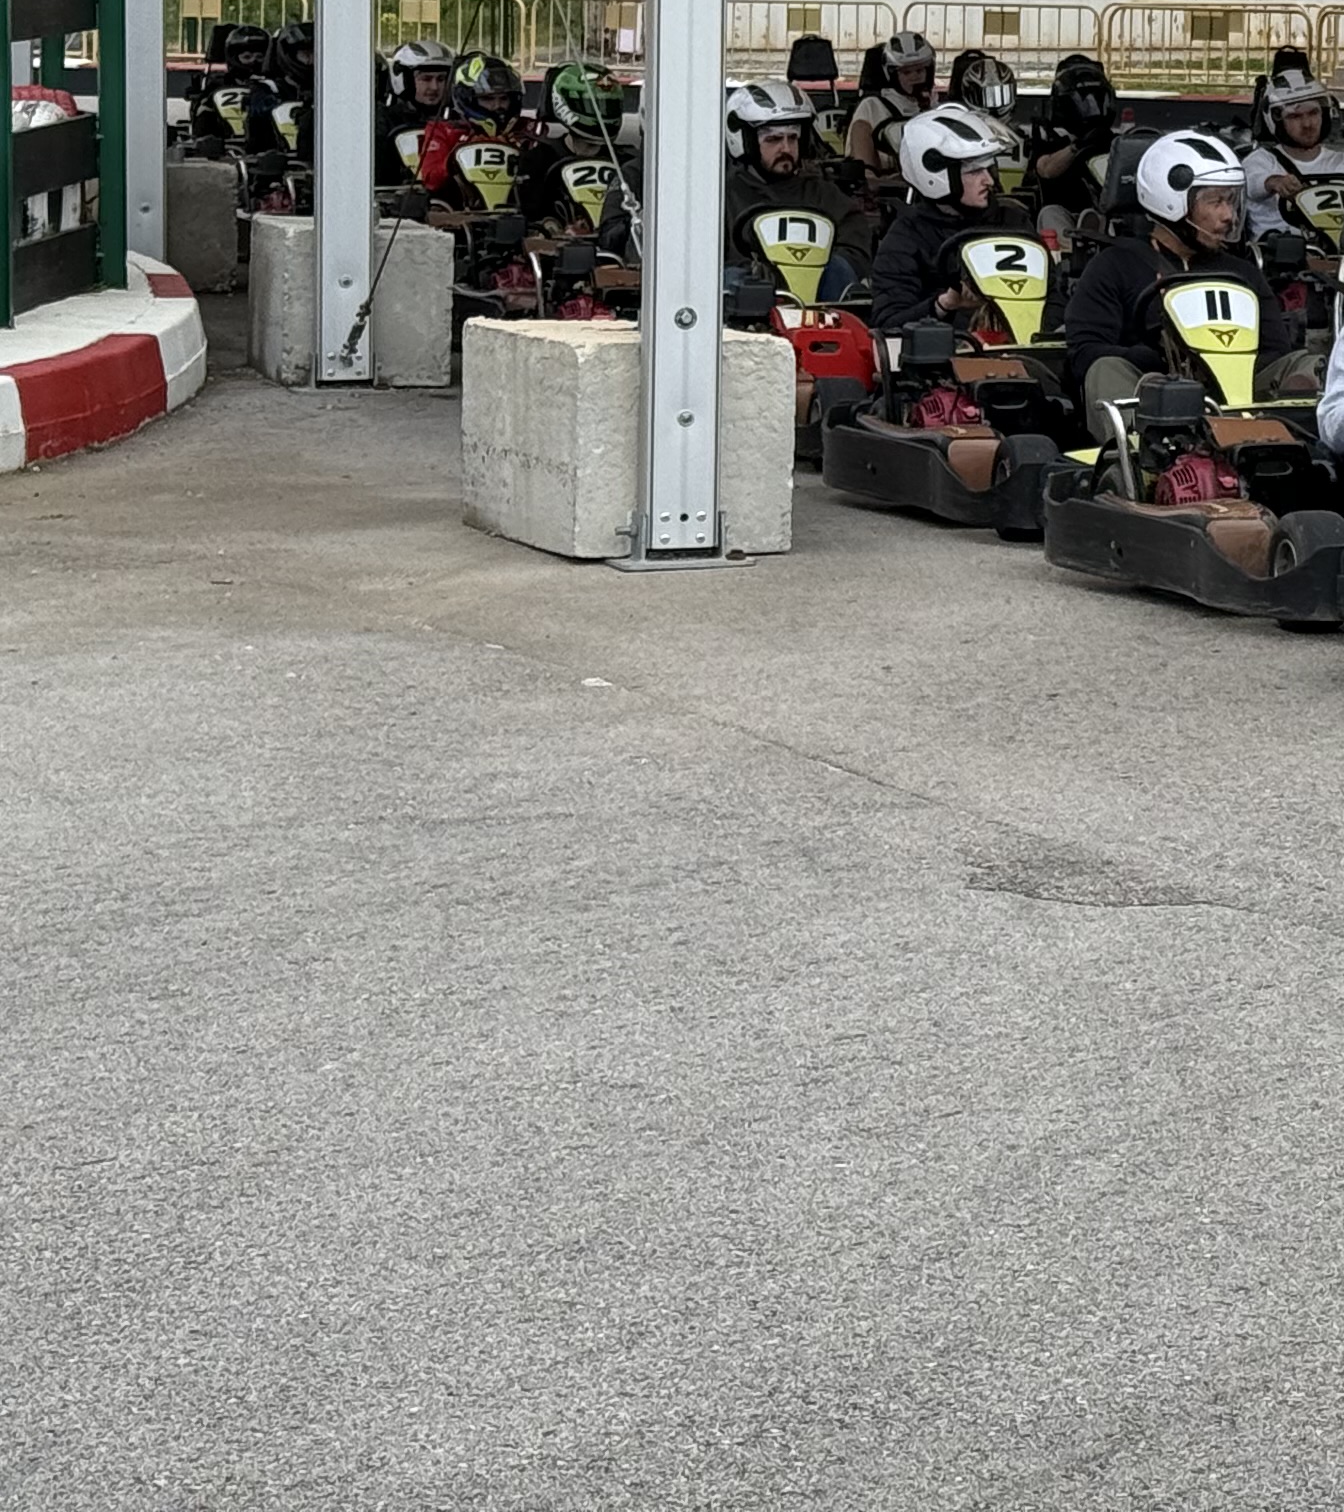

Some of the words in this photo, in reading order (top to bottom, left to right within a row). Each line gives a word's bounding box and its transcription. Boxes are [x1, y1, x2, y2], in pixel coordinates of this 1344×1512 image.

[474, 148, 505, 167] 13
[778, 216, 817, 244] 17
[994, 244, 1028, 273] 2
[1205, 290, 1230, 321] 11
